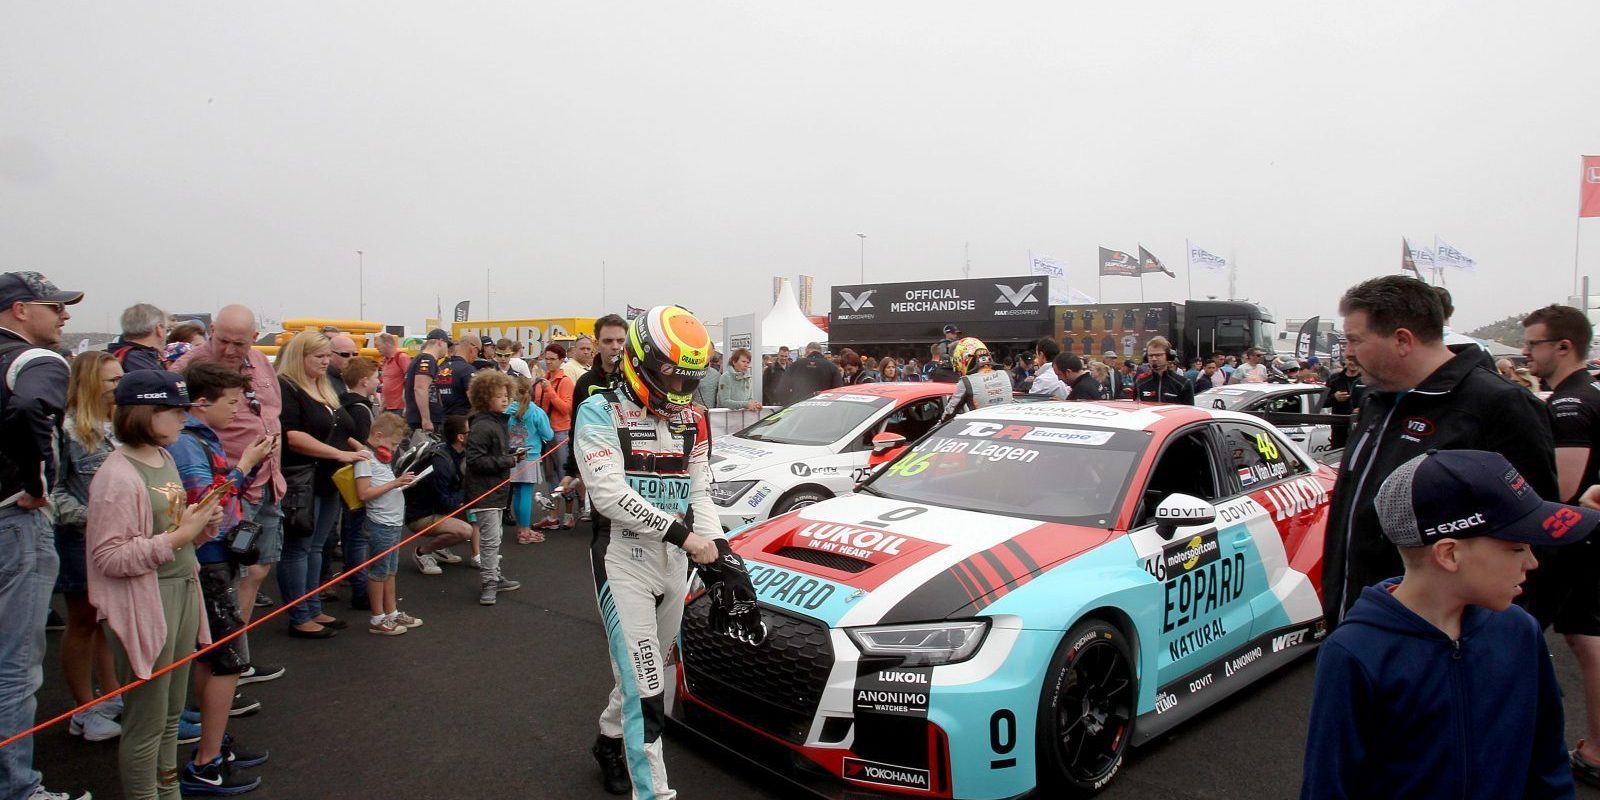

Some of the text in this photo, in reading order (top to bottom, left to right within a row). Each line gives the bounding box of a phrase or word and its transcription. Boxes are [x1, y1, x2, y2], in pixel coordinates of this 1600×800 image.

[905, 289, 960, 301] OFFICIAL
[890, 300, 976, 312] MERCHANDISE
[1009, 405, 1120, 417] ANONIMO
[957, 422, 1092, 441] TCR Europe
[584, 447, 613, 464] LUKOIL
[913, 438, 1040, 463] J. Van Lagen
[1256, 432, 1279, 460] 46
[854, 466, 871, 484] 25
[887, 452, 937, 478] 46
[1254, 464, 1270, 481] Van
[1266, 461, 1288, 479] Lagen
[629, 478, 690, 500] LEOPARD
[1265, 476, 1329, 521] LUKOIL
[617, 493, 669, 533] LEOPARD
[1159, 507, 1206, 518] DOVIT
[1220, 501, 1258, 523] DOVIT
[1437, 512, 1486, 533] exact
[1541, 507, 1583, 539] 33
[798, 522, 908, 555] LUKOIL
[808, 539, 873, 559] IN MY HEART
[1167, 540, 1217, 567] motorsport.com
[1162, 552, 1245, 635] EOPARD
[1074, 631, 1097, 652] YOKOHAMA
[1169, 616, 1227, 662] NATURAL
[1272, 628, 1310, 653] WRT
[638, 638, 661, 691] LEOPARD
[1233, 646, 1262, 672] ANONIMO
[878, 670, 928, 684] LUKOIL
[1189, 673, 1213, 693] DOVIT
[857, 690, 927, 705] ANONIMO
[875, 704, 908, 713] WATCHES
[864, 766, 927, 786] YOKOHAMA
